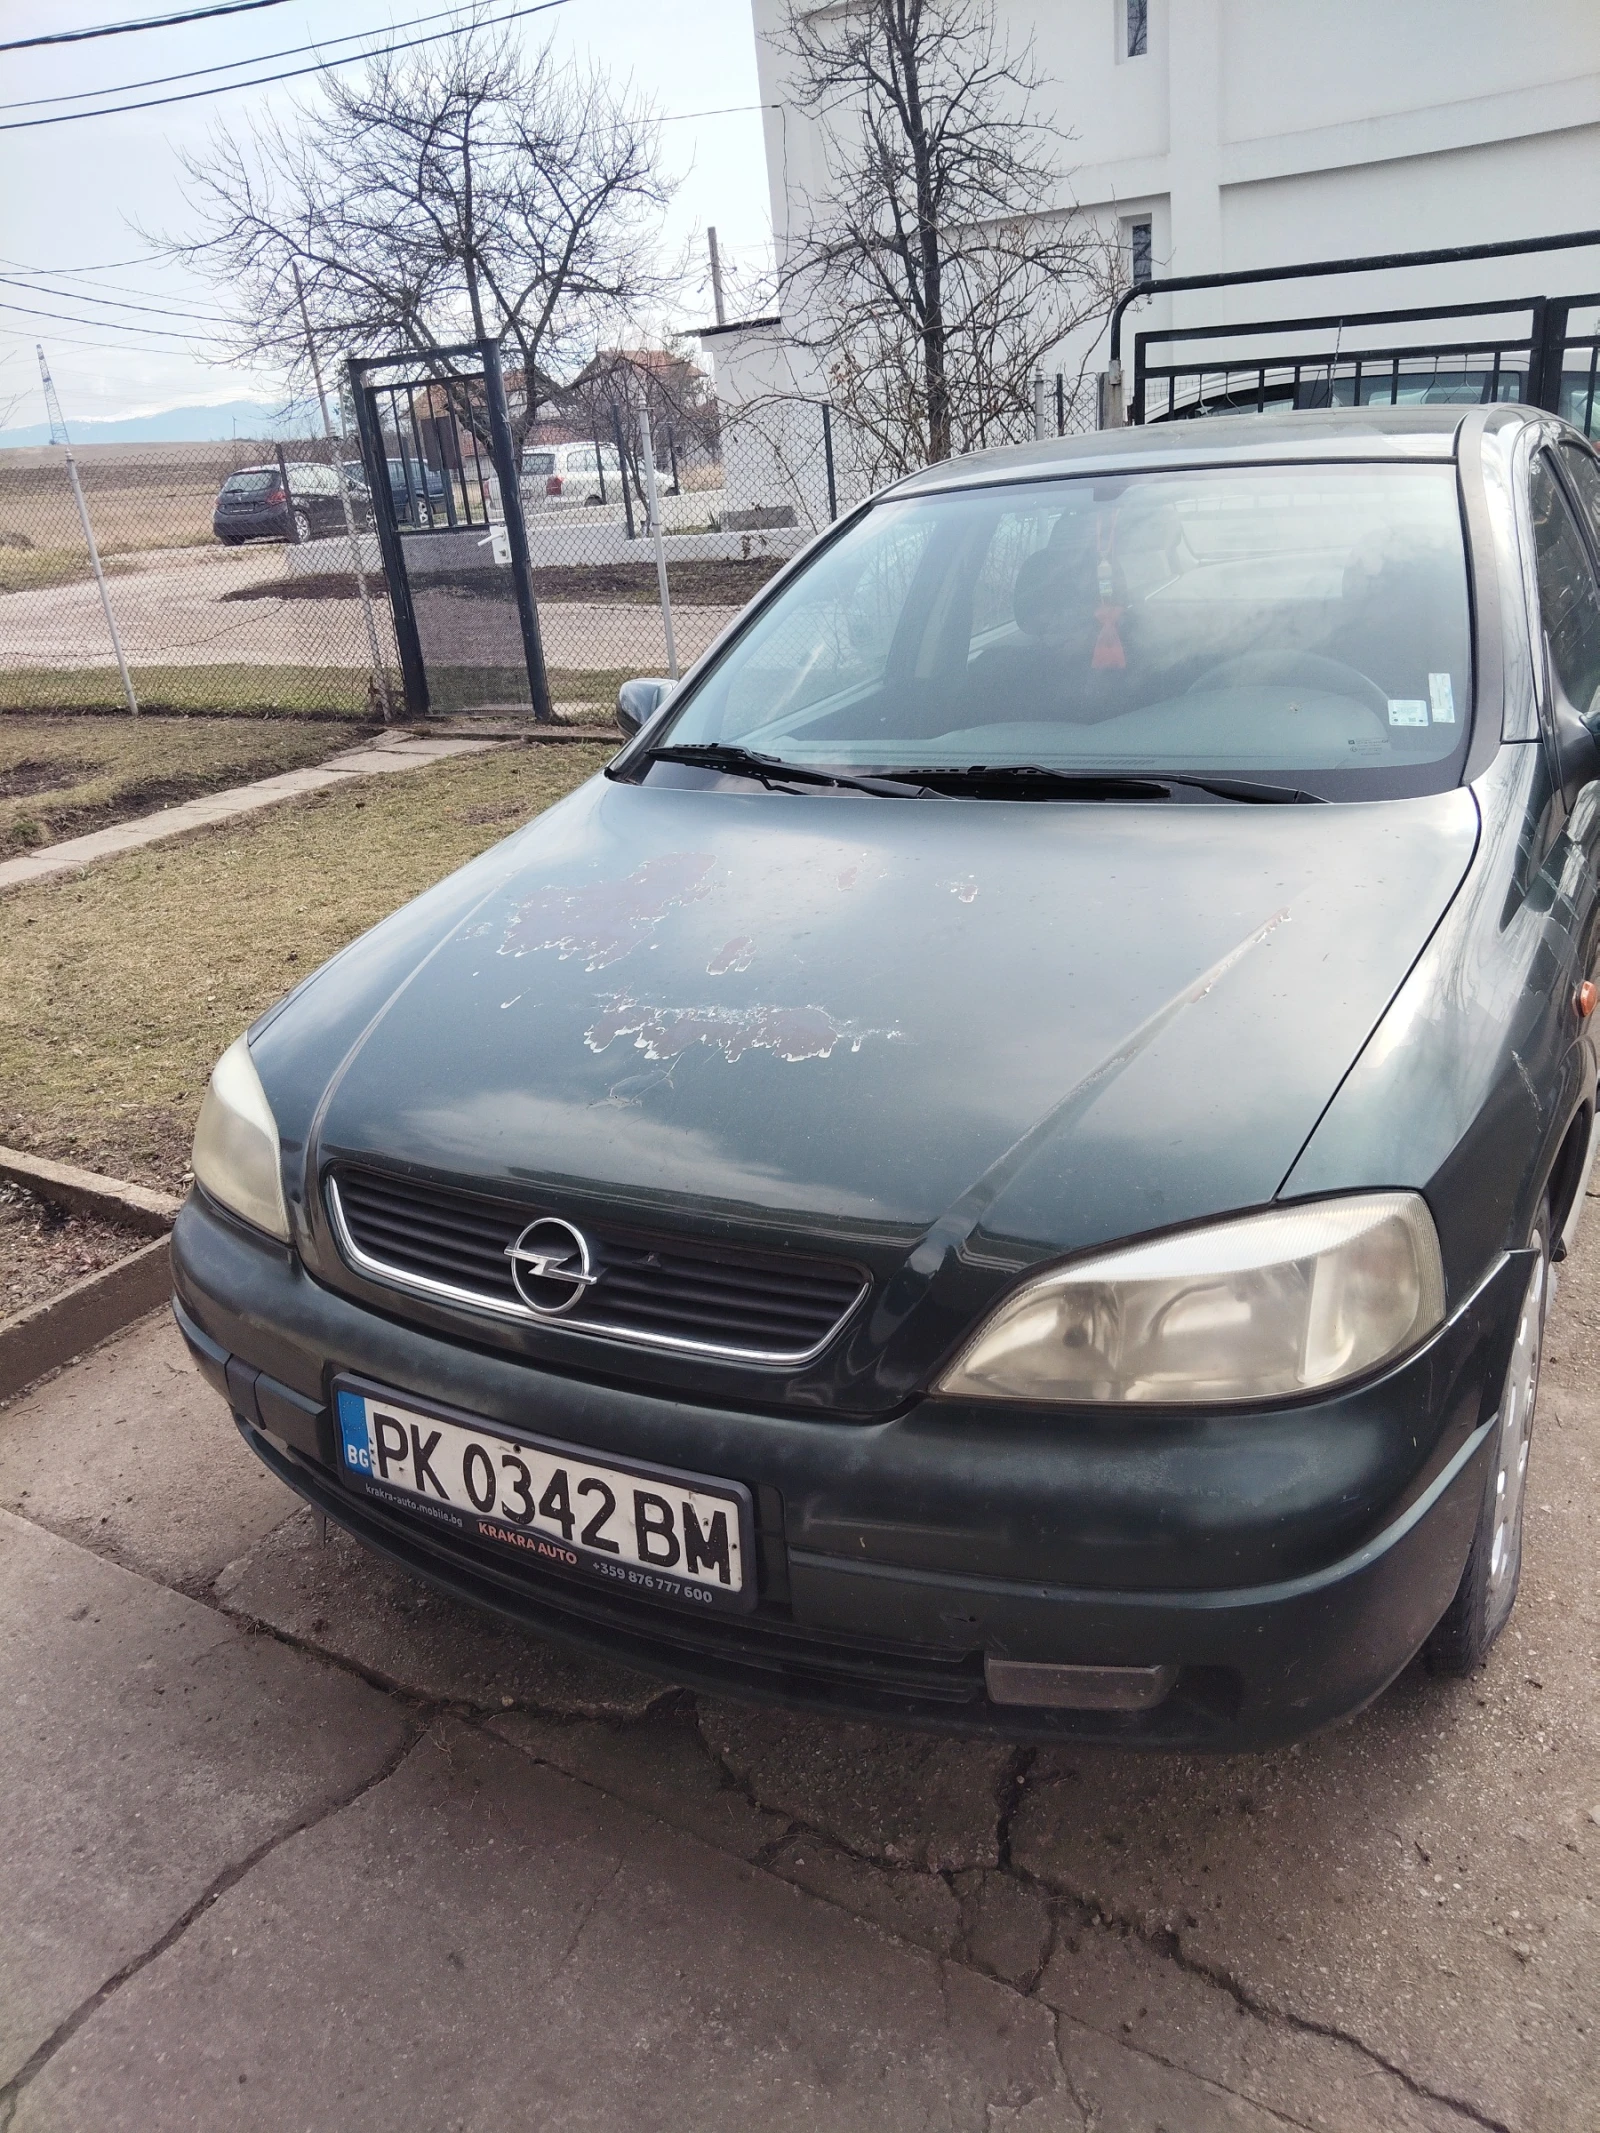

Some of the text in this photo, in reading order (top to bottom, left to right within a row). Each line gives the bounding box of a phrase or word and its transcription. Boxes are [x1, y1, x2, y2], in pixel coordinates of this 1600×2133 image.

[347, 1444, 370, 1468] BG
[365, 1483, 463, 1527] krakra-auto.mobile.bg
[373, 1412, 731, 1585] PK 0342 BM
[478, 1522, 578, 1565] KRAKRA AUTO
[592, 1562, 713, 1603] +359 876 777 600
